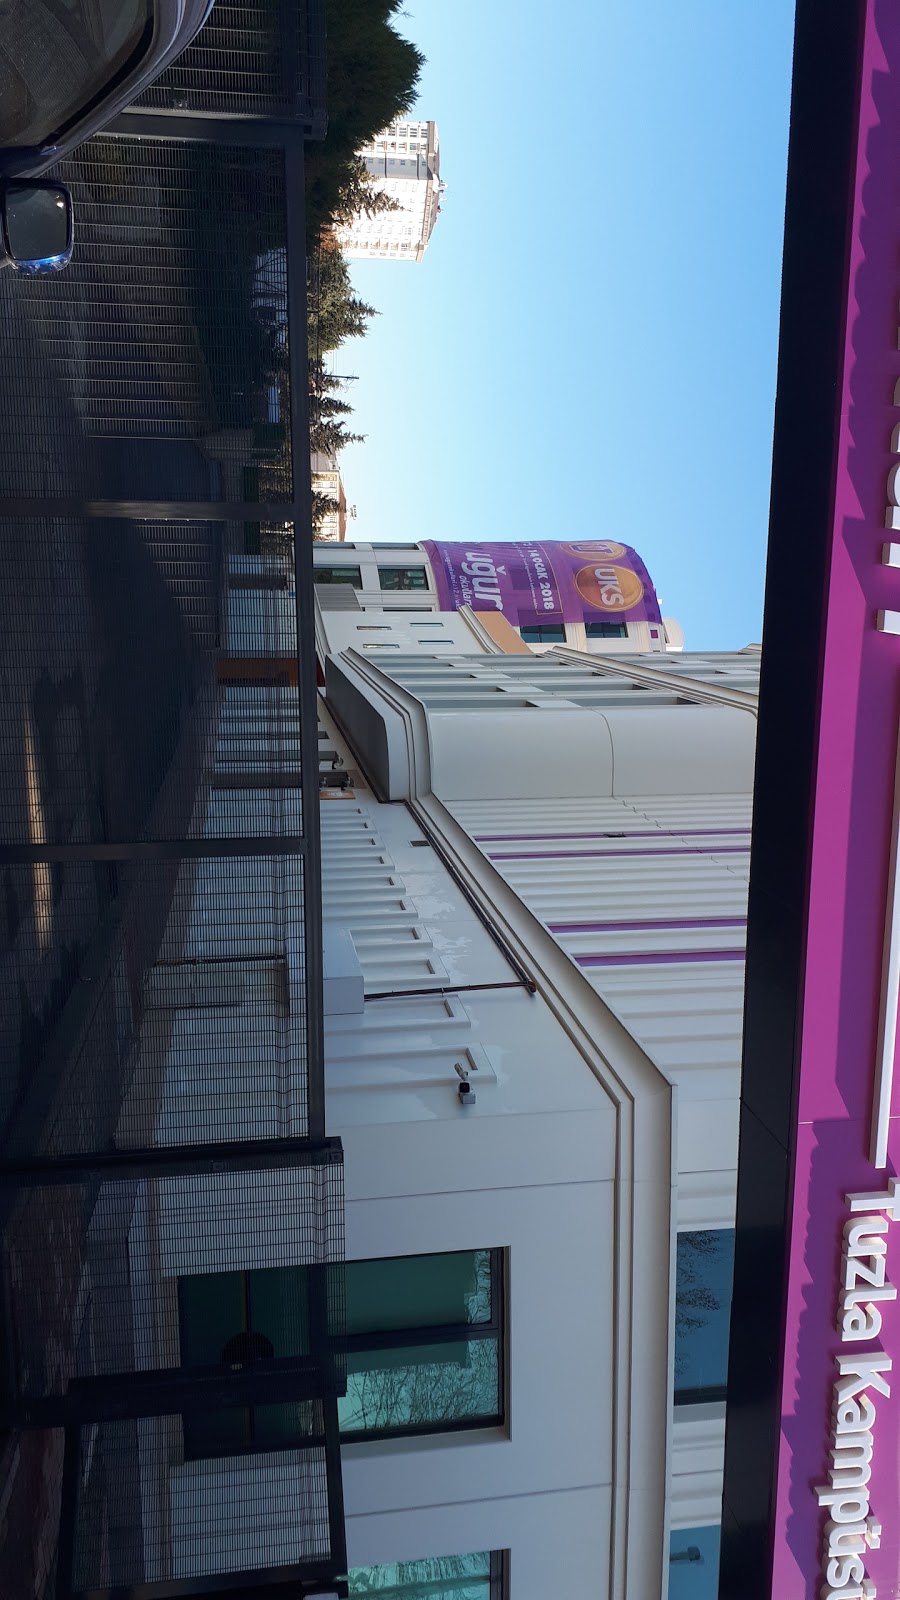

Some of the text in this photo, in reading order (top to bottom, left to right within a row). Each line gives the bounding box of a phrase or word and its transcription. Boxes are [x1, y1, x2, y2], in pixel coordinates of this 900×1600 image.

[528, 549, 540, 557] 14
[532, 558, 548, 580] OCAK
[460, 552, 507, 610] uğur
[540, 582, 554, 610] 2018
[594, 568, 624, 606] UKS
[837, 1178, 900, 1342] Tuzla
